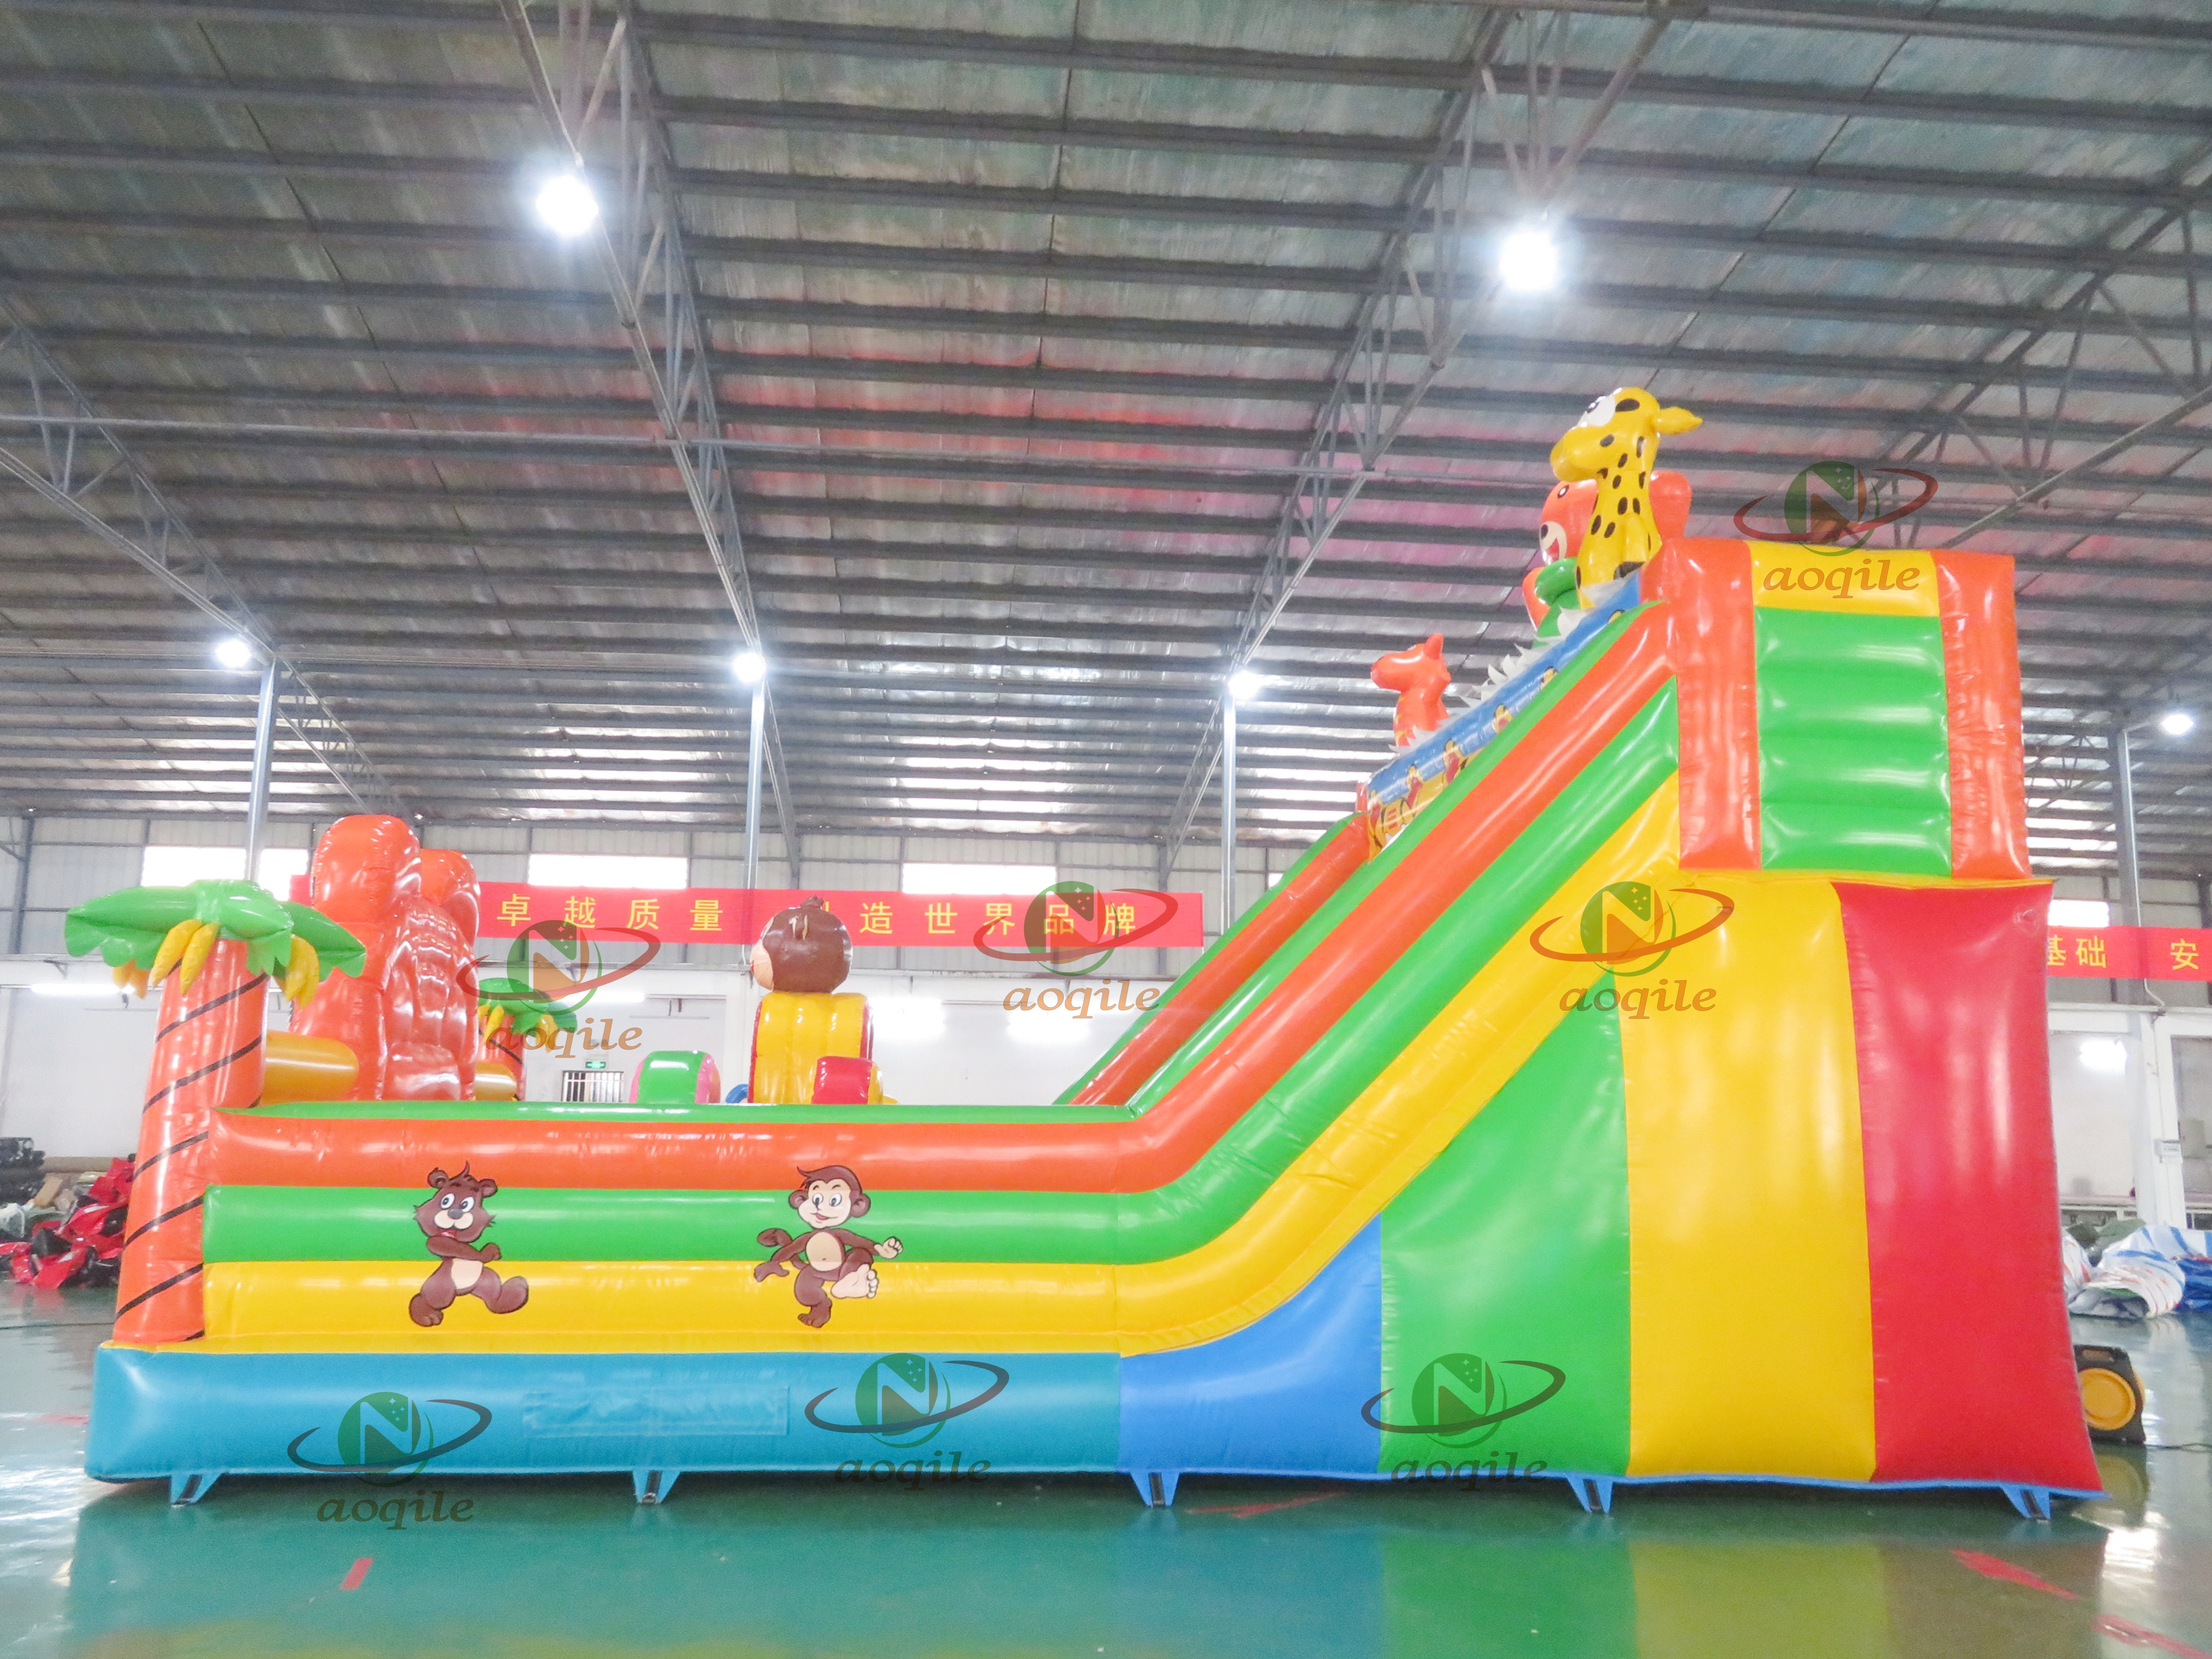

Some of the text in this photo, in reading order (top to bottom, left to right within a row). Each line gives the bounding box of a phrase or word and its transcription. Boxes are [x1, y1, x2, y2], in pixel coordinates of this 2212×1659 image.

[497, 894, 1135, 936] 卓越质量 造世界品牌
[2170, 938, 2199, 970] 安
